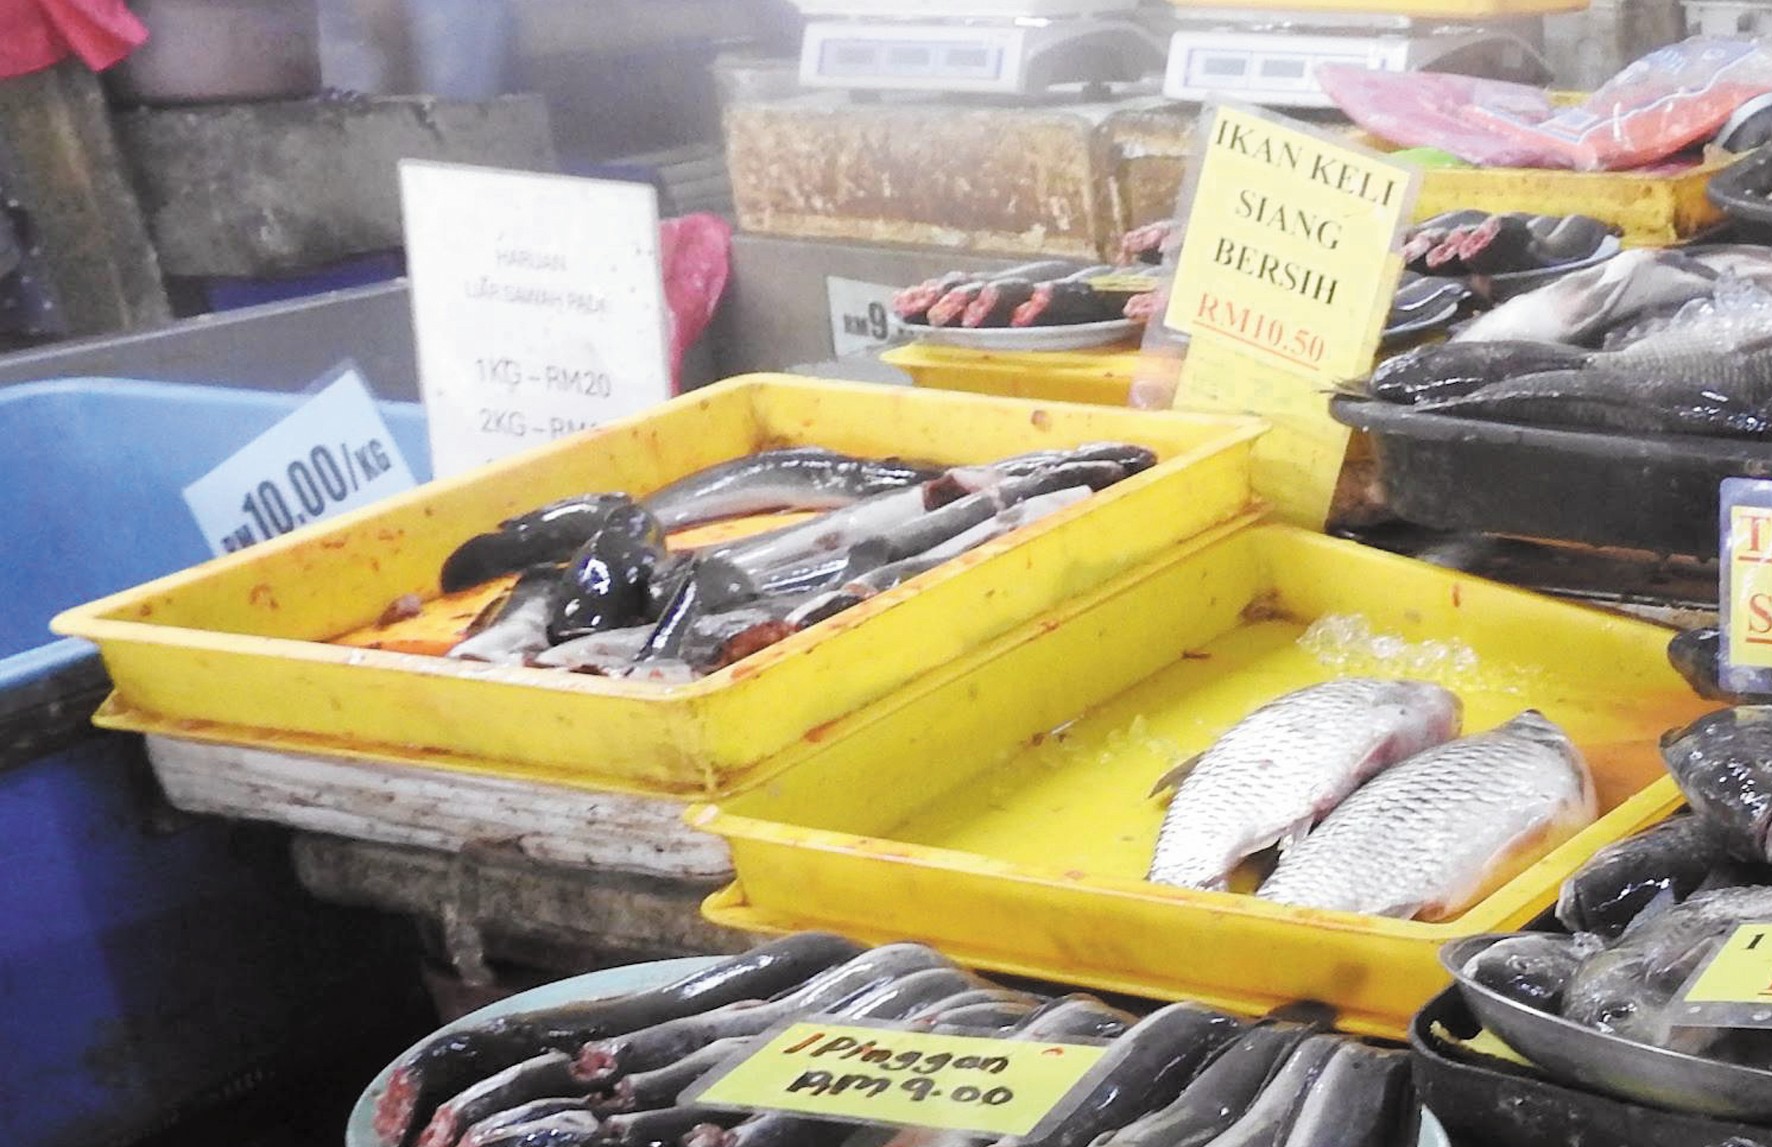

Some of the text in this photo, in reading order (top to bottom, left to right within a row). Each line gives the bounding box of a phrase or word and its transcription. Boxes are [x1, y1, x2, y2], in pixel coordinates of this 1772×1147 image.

[1215, 120, 1398, 207] IKAN KELI
[1235, 189, 1343, 250] SIANG
[1213, 237, 1340, 306] BERSIH
[1196, 293, 1325, 363] RM10.50
[1745, 933, 1765, 951] 1
